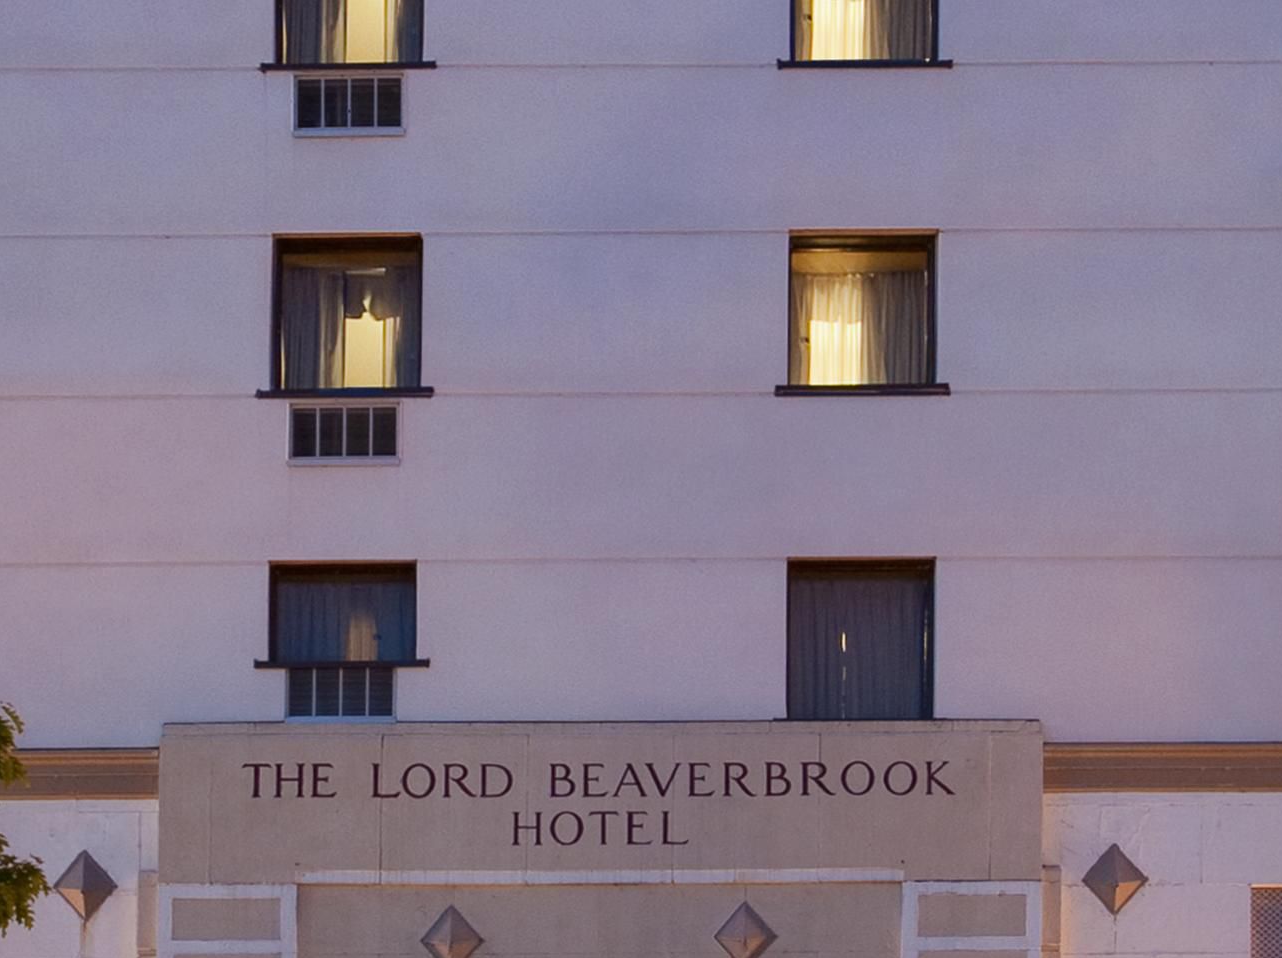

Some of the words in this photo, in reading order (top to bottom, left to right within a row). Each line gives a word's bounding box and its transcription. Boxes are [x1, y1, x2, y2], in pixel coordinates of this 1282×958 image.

[241, 762, 338, 799] THE
[370, 762, 514, 800] LORD
[548, 760, 957, 799] BEAVERBROOK
[510, 810, 690, 847] HOTEL
